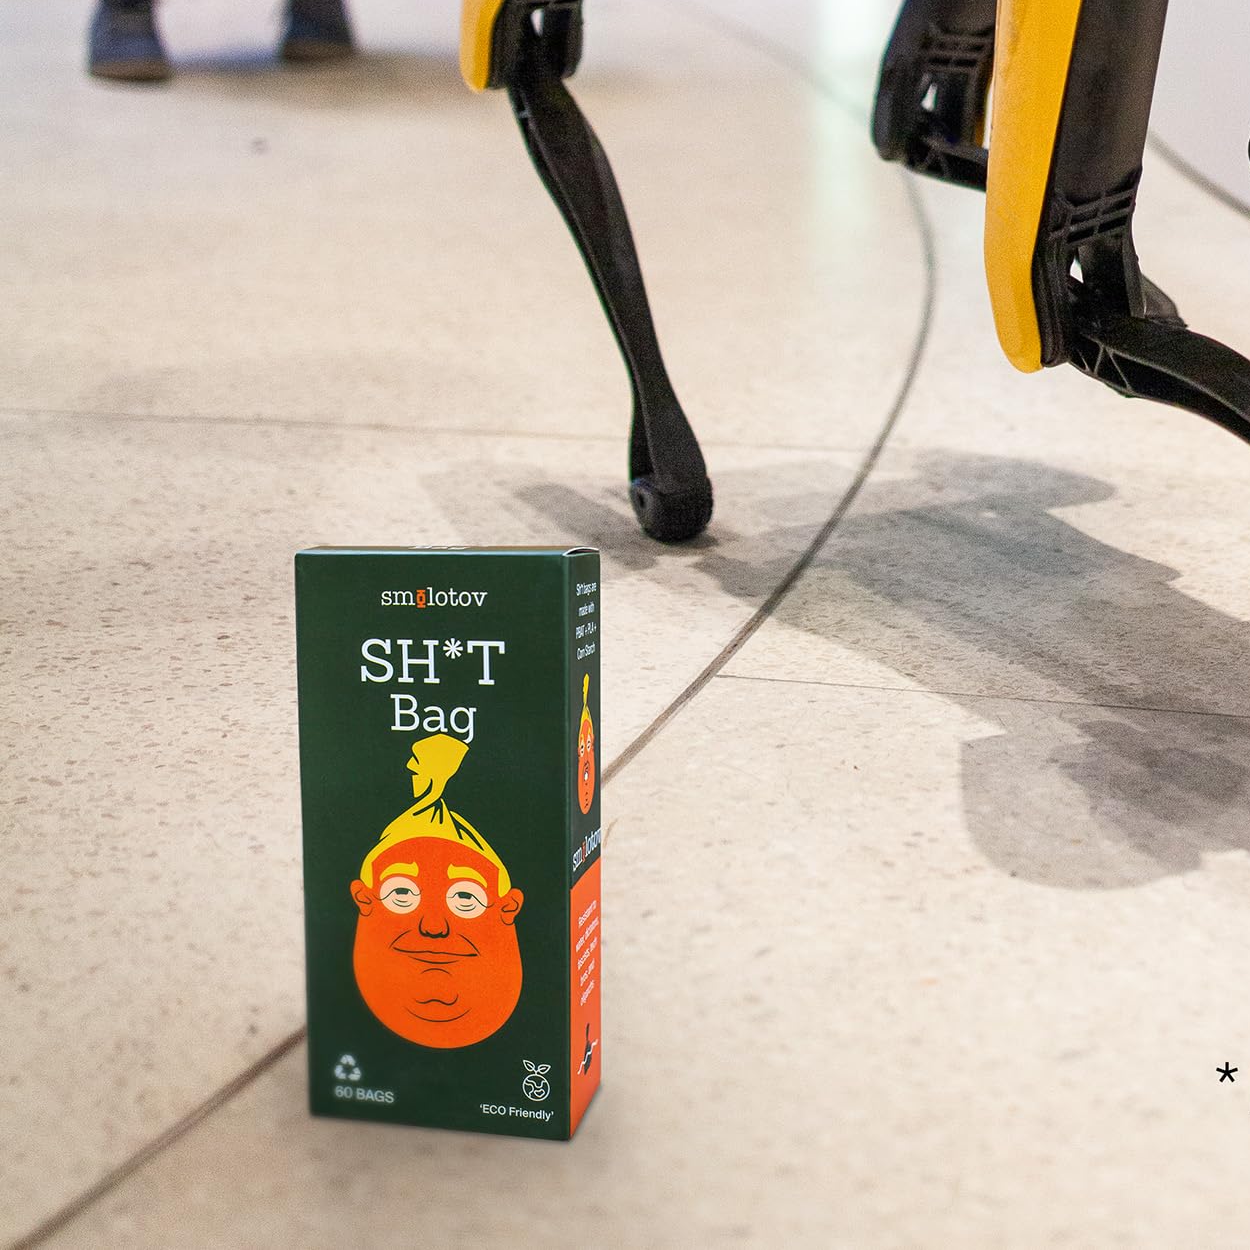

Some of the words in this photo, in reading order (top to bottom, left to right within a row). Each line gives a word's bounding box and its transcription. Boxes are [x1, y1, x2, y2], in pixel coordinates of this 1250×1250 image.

[390, 693, 477, 744] Bag
[335, 1085, 353, 1099] 60
[356, 1089, 395, 1104] BAGS
